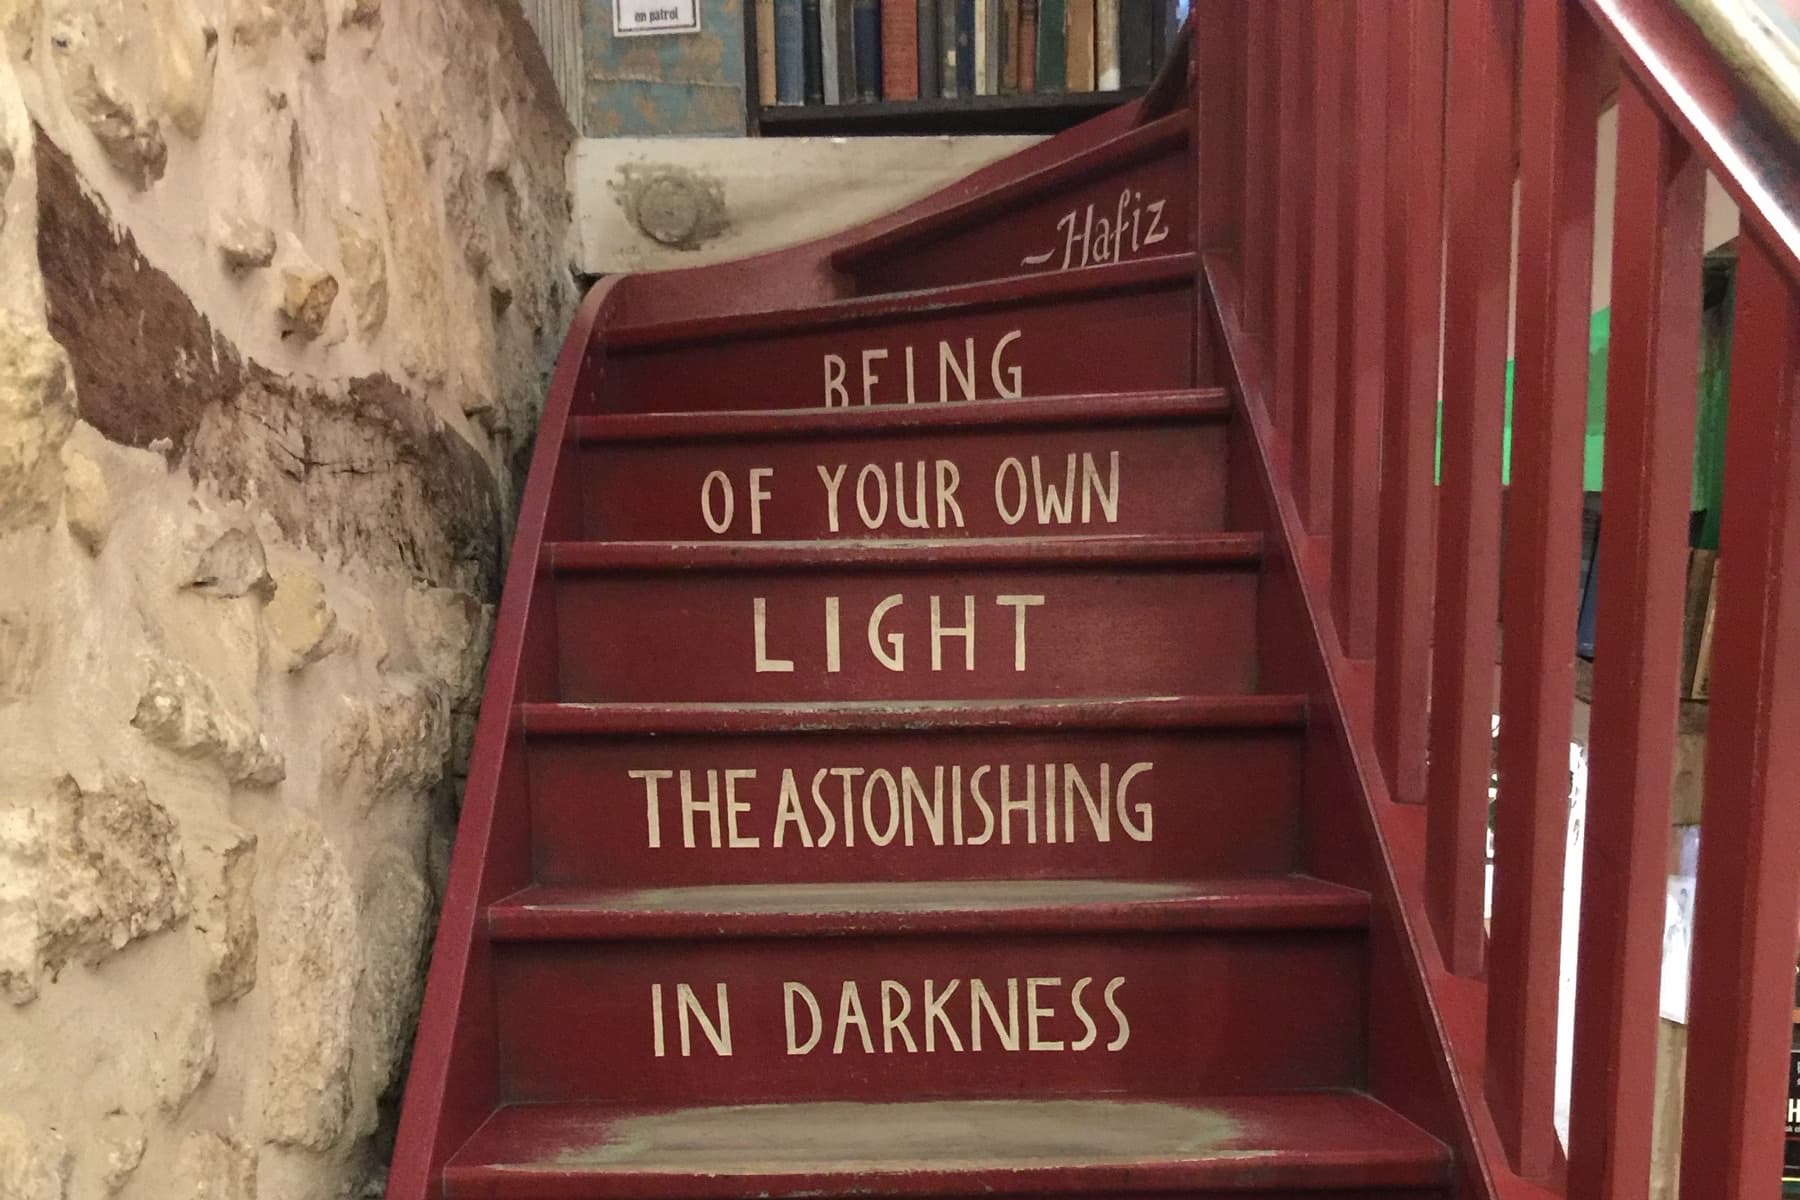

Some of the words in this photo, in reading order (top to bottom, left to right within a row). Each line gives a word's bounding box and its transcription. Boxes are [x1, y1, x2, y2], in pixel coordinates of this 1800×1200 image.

[649, 7, 679, 22] patrol
[823, 329, 1022, 408] BEING
[701, 467, 774, 534] OF
[817, 459, 965, 532] YOUR
[996, 451, 1119, 525] OWN
[753, 593, 1046, 673] LIGHT
[628, 769, 760, 848] THE
[773, 762, 1153, 848] ASTONISHING
[652, 982, 733, 1057] IN
[783, 975, 1130, 1055] DARKNESS
